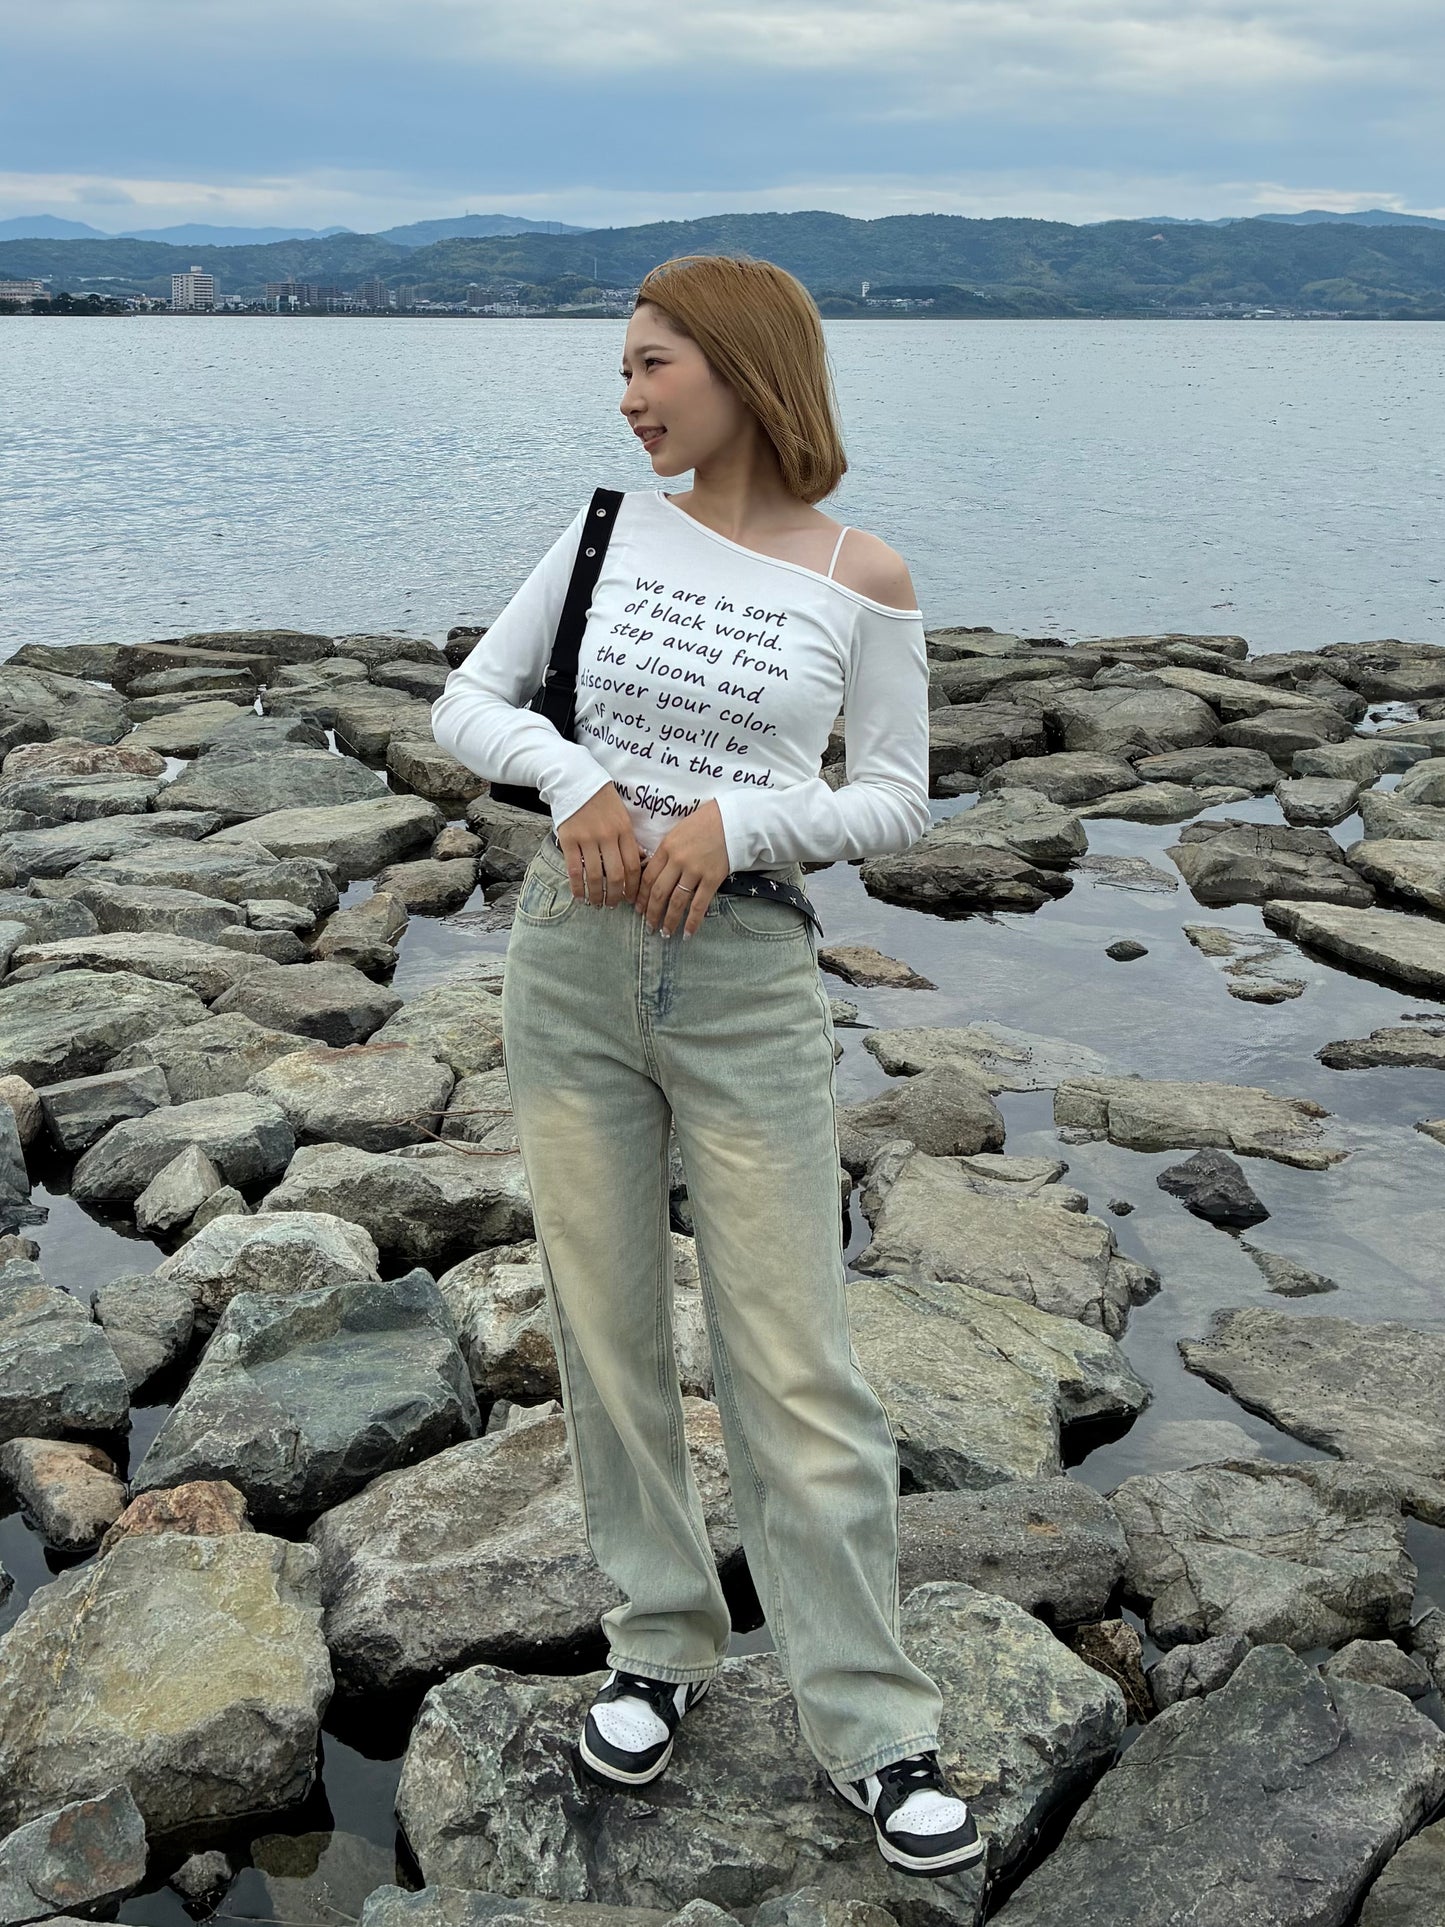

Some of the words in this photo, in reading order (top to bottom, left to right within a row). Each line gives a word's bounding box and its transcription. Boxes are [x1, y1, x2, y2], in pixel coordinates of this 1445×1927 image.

[624, 599, 649, 616] of
[650, 603, 706, 631] black
[715, 623, 783, 651] world.
[635, 577, 665, 595] We
[672, 590, 707, 606] are
[714, 596, 735, 613] in
[742, 605, 788, 627] sort
[596, 646, 627, 666] the
[636, 656, 706, 687] Jloom
[717, 681, 765, 704] and
[610, 622, 654, 645] step
[663, 637, 723, 665] away
[732, 649, 789, 681] from
[580, 668, 649, 698] discover
[656, 692, 711, 714] your
[719, 709, 777, 737] color.
[594, 702, 606, 718] If
[612, 711, 651, 733] not,
[658, 724, 720, 749] you'll
[725, 736, 749, 755] be
[660, 746, 680, 767] in
[689, 756, 723, 778] the
[732, 769, 775, 789] end,
